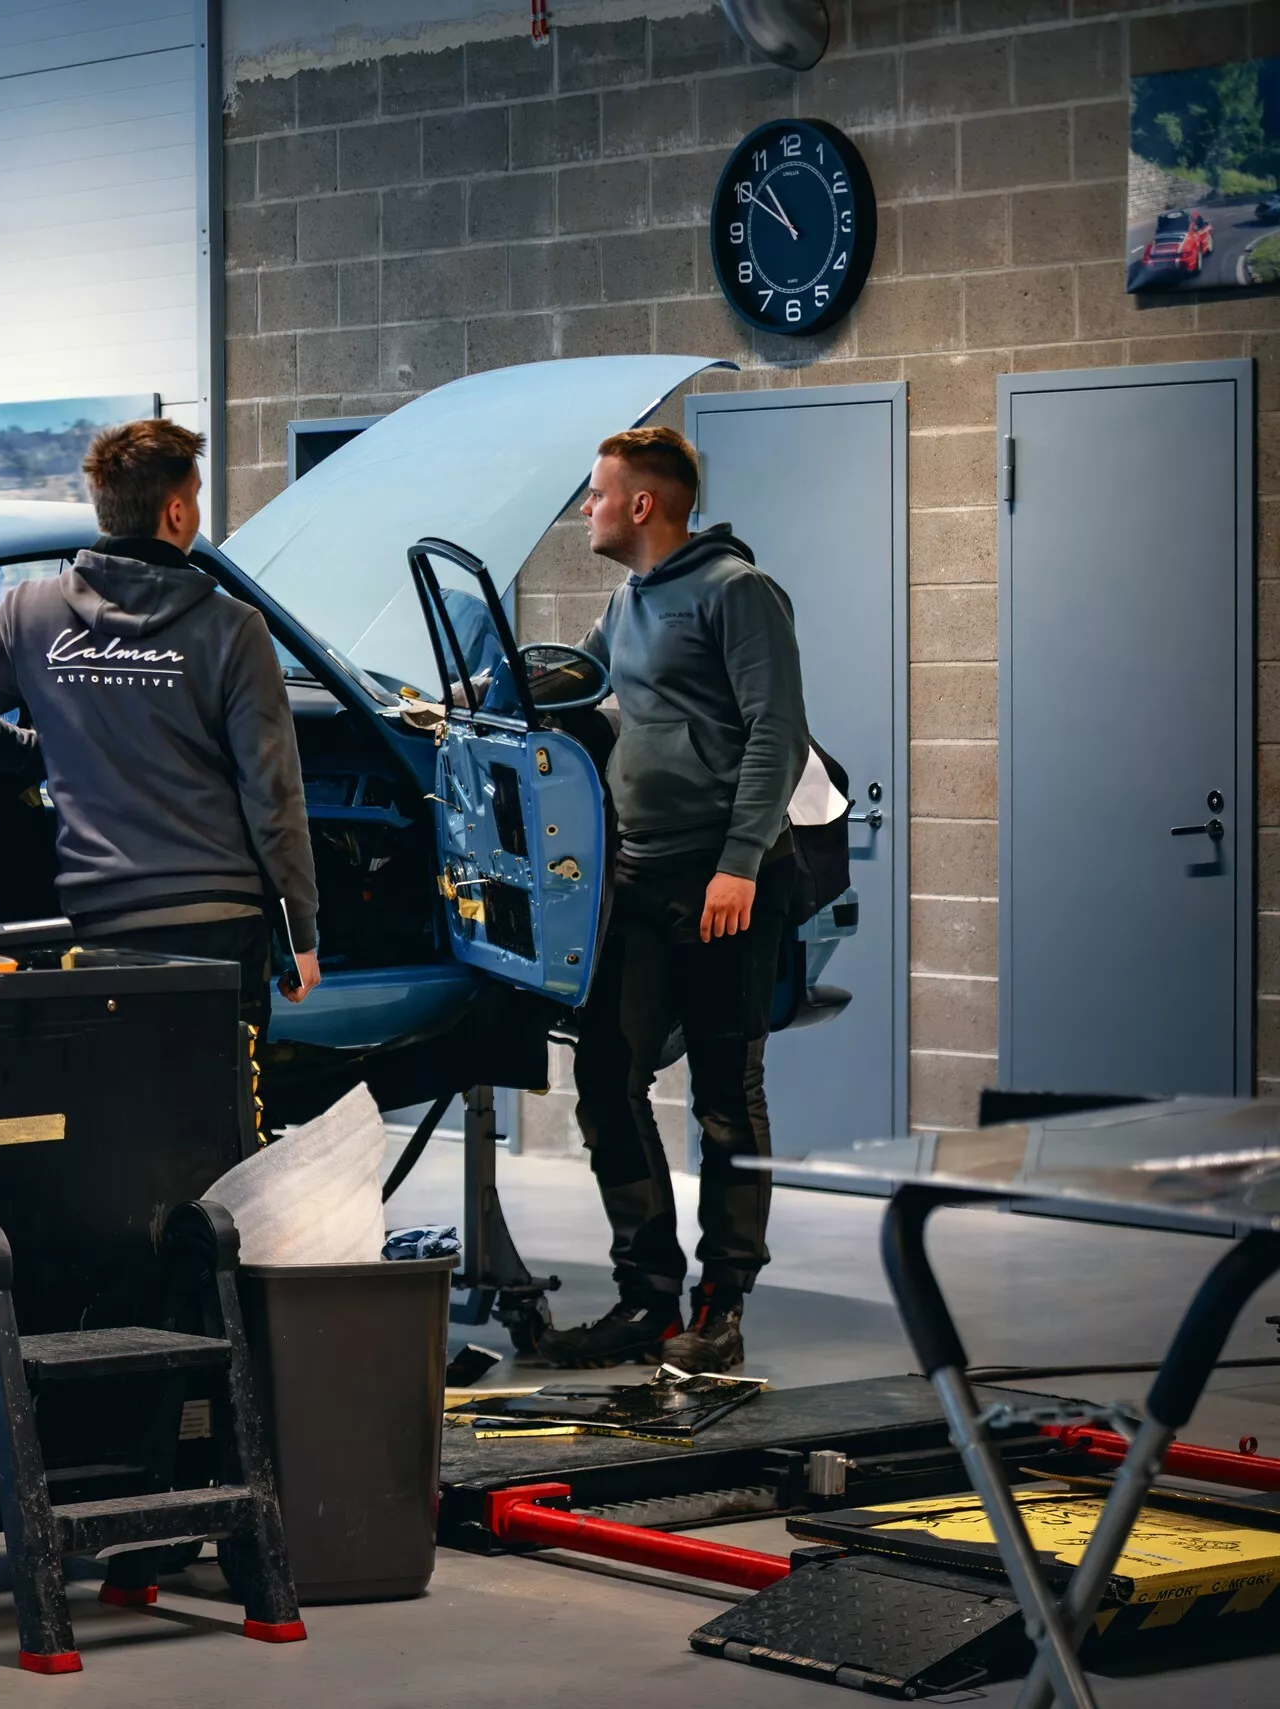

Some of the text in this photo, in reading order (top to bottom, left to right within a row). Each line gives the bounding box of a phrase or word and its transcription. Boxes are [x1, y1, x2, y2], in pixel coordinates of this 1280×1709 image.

[780, 135, 801, 157] 12
[816, 143, 824, 164] 1
[752, 149, 767, 171] 11
[734, 181, 753, 204] 10
[833, 171, 848, 193] 2
[841, 211, 851, 232] 3
[730, 222, 743, 244] 9
[833, 251, 847, 270] 4
[738, 261, 753, 283] 8
[758, 290, 773, 312] 7
[814, 285, 829, 307] 5
[785, 300, 801, 322] 6
[46, 628, 184, 664] Kalmar
[56, 674, 174, 688] AUTOMOTIVE
